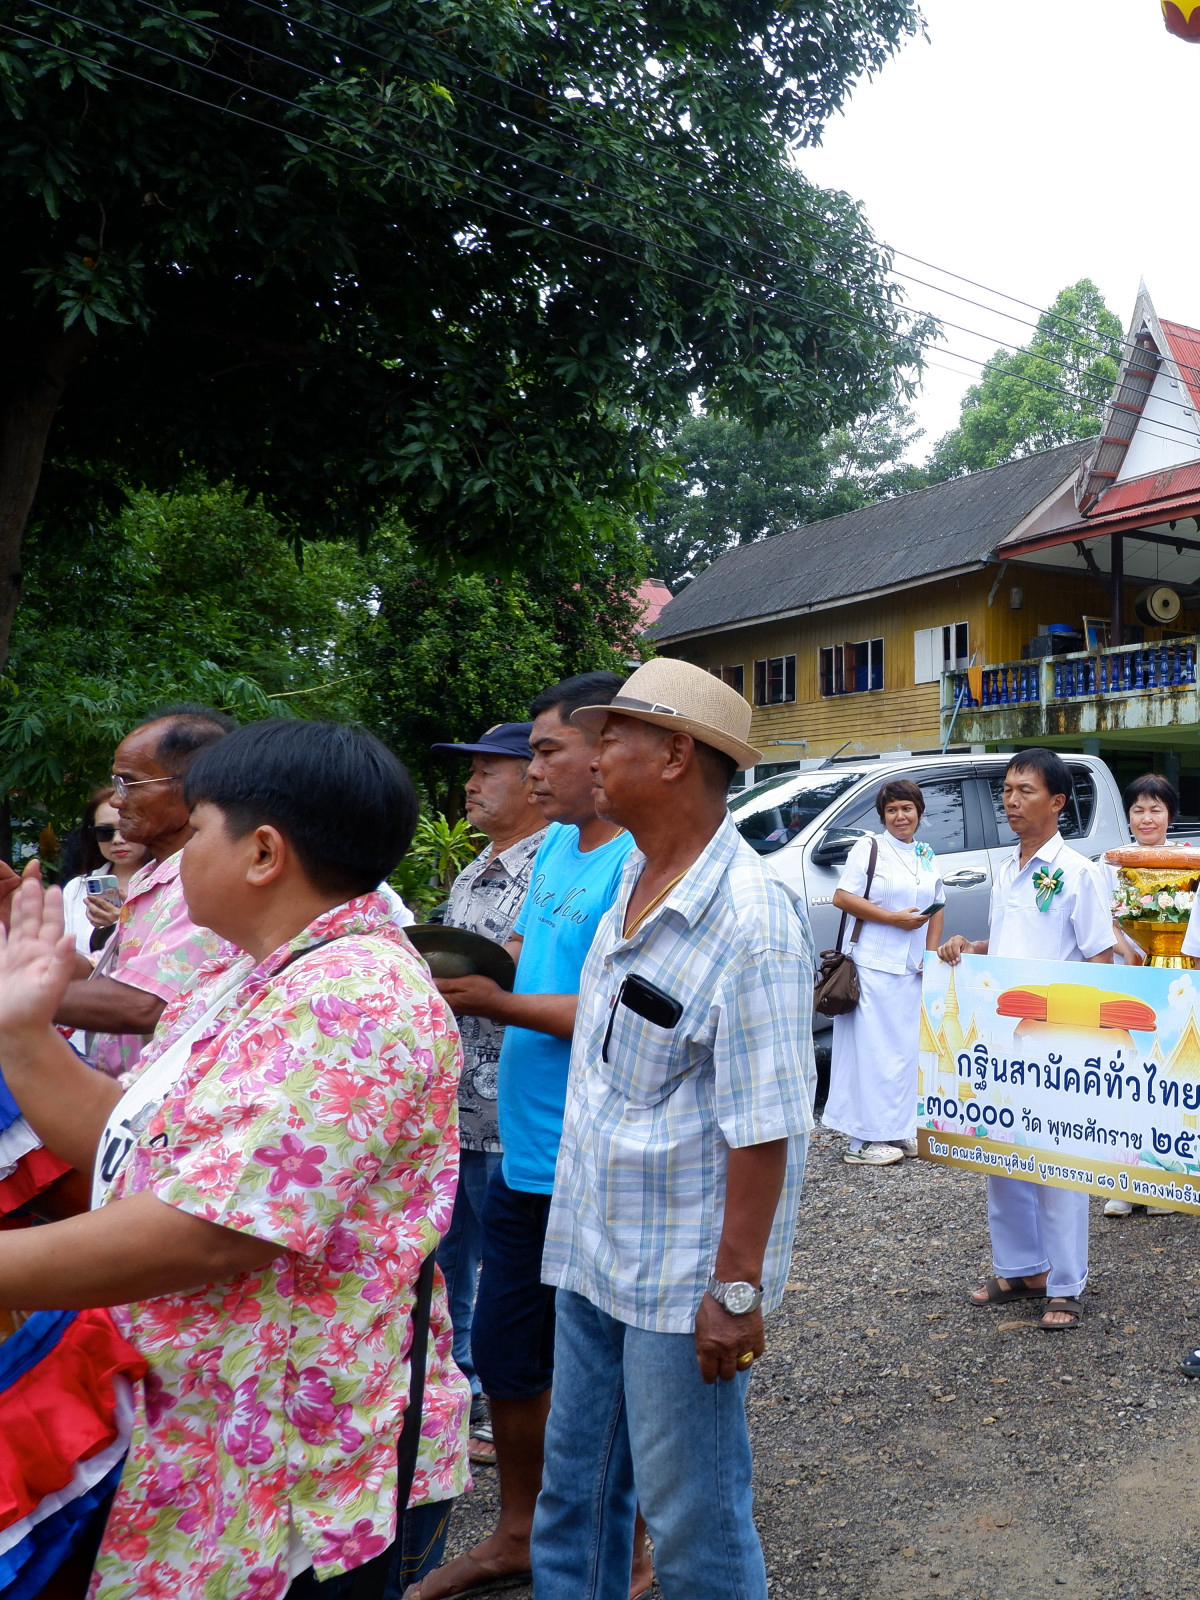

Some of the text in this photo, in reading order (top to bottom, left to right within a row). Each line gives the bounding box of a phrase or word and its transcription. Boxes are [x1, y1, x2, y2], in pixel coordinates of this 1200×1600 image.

[811, 896, 833, 906] HIL
[957, 1043, 1200, 1110] กฐินสามัคคีทั่วไทย
[926, 1095, 1015, 1129] ๓๐,๐๐๐
[1021, 1107, 1042, 1133] วัด
[1047, 1117, 1143, 1150] พุทธศักราช
[929, 1138, 948, 1155] โดย
[952, 1147, 1035, 1173] คณะศิษยานุศิษย์
[1038, 1163, 1093, 1183] บูชาธรรม
[1097, 1174, 1115, 1188] ๘๑
[1119, 1173, 1128, 1190] ปี
